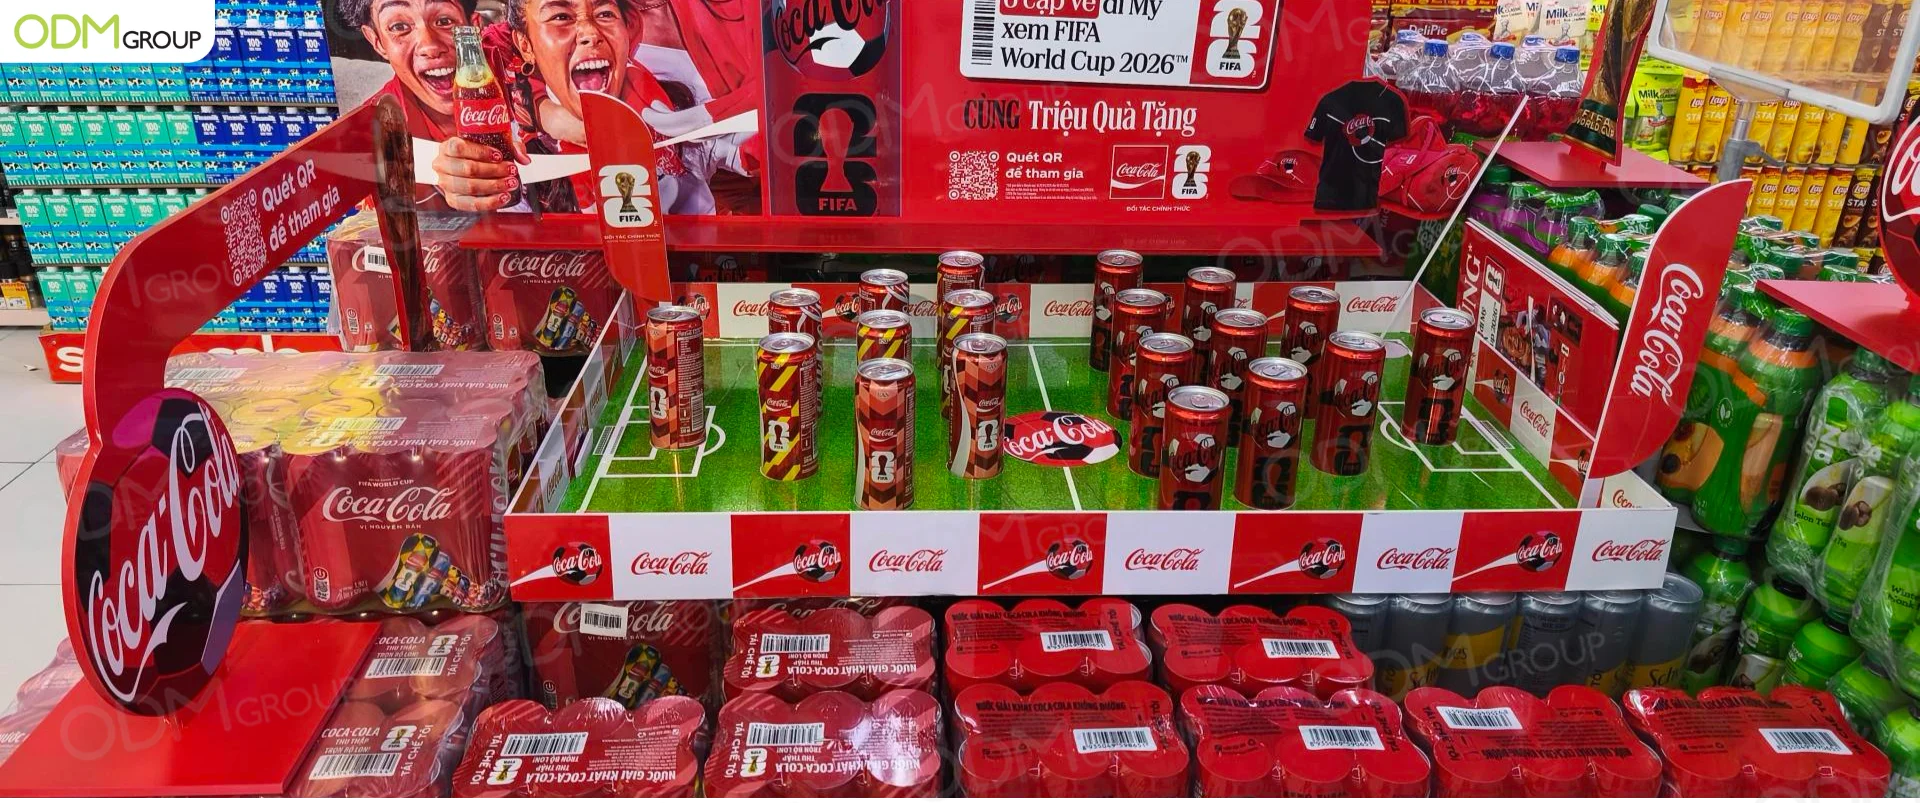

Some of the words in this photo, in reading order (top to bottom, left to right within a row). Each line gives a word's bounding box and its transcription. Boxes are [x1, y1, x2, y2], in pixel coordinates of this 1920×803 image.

[1546, 9, 1568, 19] Milk
[1001, 22, 1049, 41] xem
[1054, 20, 1101, 42] FIFA
[1409, 24, 1448, 36] DeliPie
[1000, 46, 1066, 71] World
[1070, 52, 1115, 76] Cup
[1219, 61, 1241, 72] FIFA
[1638, 90, 1659, 99] Milk
[963, 92, 1021, 130] CÙNG
[1028, 100, 1088, 137] Triệu
[1092, 100, 1136, 131] Quà
[1141, 101, 1198, 138] Tặng
[1006, 151, 1040, 164] Quét
[1043, 152, 1063, 164] QR
[1025, 167, 1060, 179] tham
[1063, 167, 1084, 182] gia
[261, 172, 297, 212] Quét
[296, 158, 317, 189] QR
[288, 200, 322, 237] tham
[322, 184, 341, 217] gia
[818, 198, 858, 211] FIFA
[619, 215, 642, 223] FIFA
[1630, 263, 1704, 407] Coca-Cola
[322, 486, 457, 524] Coca-Cola
[1793, 509, 1815, 524] elon
[88, 401, 241, 702] Coca-Cola
[1592, 539, 1670, 563] Coca-Cola
[631, 551, 713, 576] Coca-Cola
[868, 548, 948, 572] Coca-Cola
[1124, 548, 1206, 571] Coca-Cola
[1376, 547, 1457, 571] Coca-Cola
[1891, 584, 1920, 599] Winte
[321, 726, 381, 738] COCA-COLA
[525, 771, 587, 783] COCA-COLA
[587, 771, 620, 782] KHÁT
[621, 770, 645, 783] GIẢI
